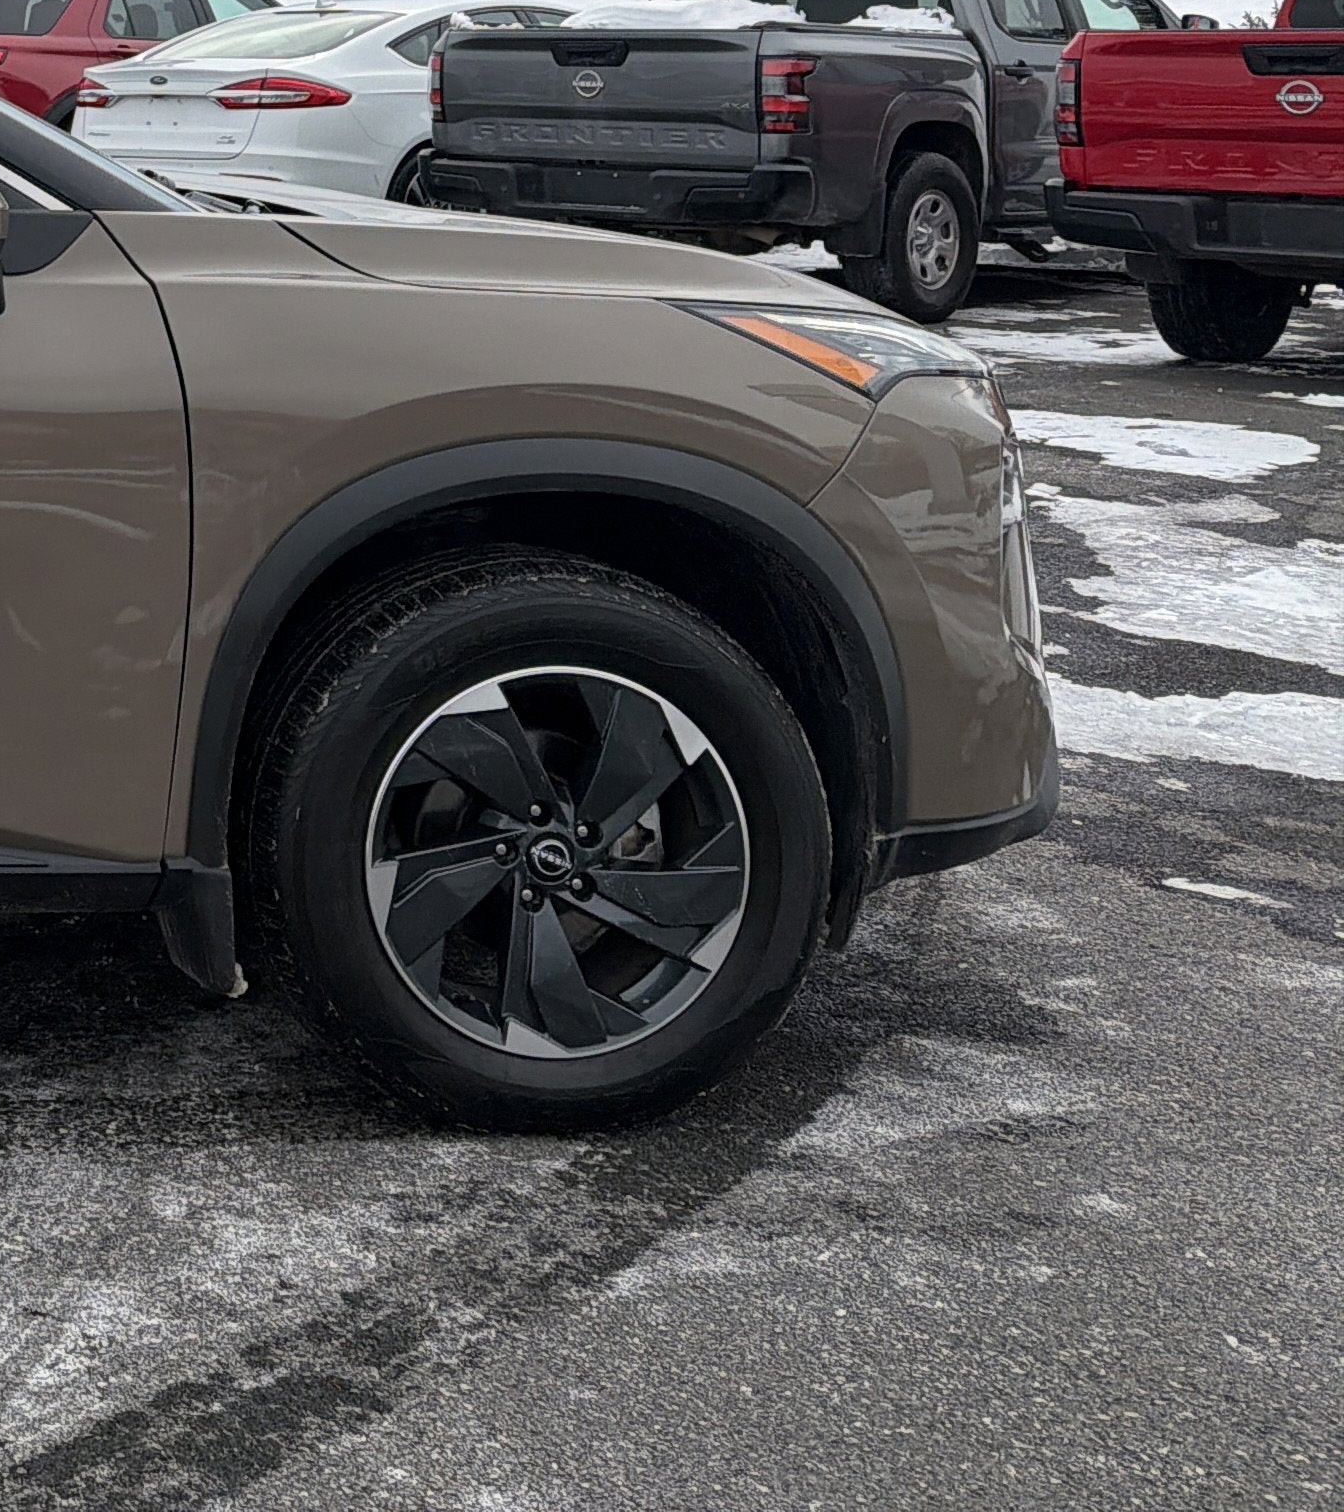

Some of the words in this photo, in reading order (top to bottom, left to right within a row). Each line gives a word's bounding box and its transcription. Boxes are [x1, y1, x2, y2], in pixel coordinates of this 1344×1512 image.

[572, 79, 605, 89] NISSAN
[1275, 93, 1324, 102] NISSAN
[472, 120, 728, 150] FRONTIER
[530, 845, 573, 870] NISSAN
